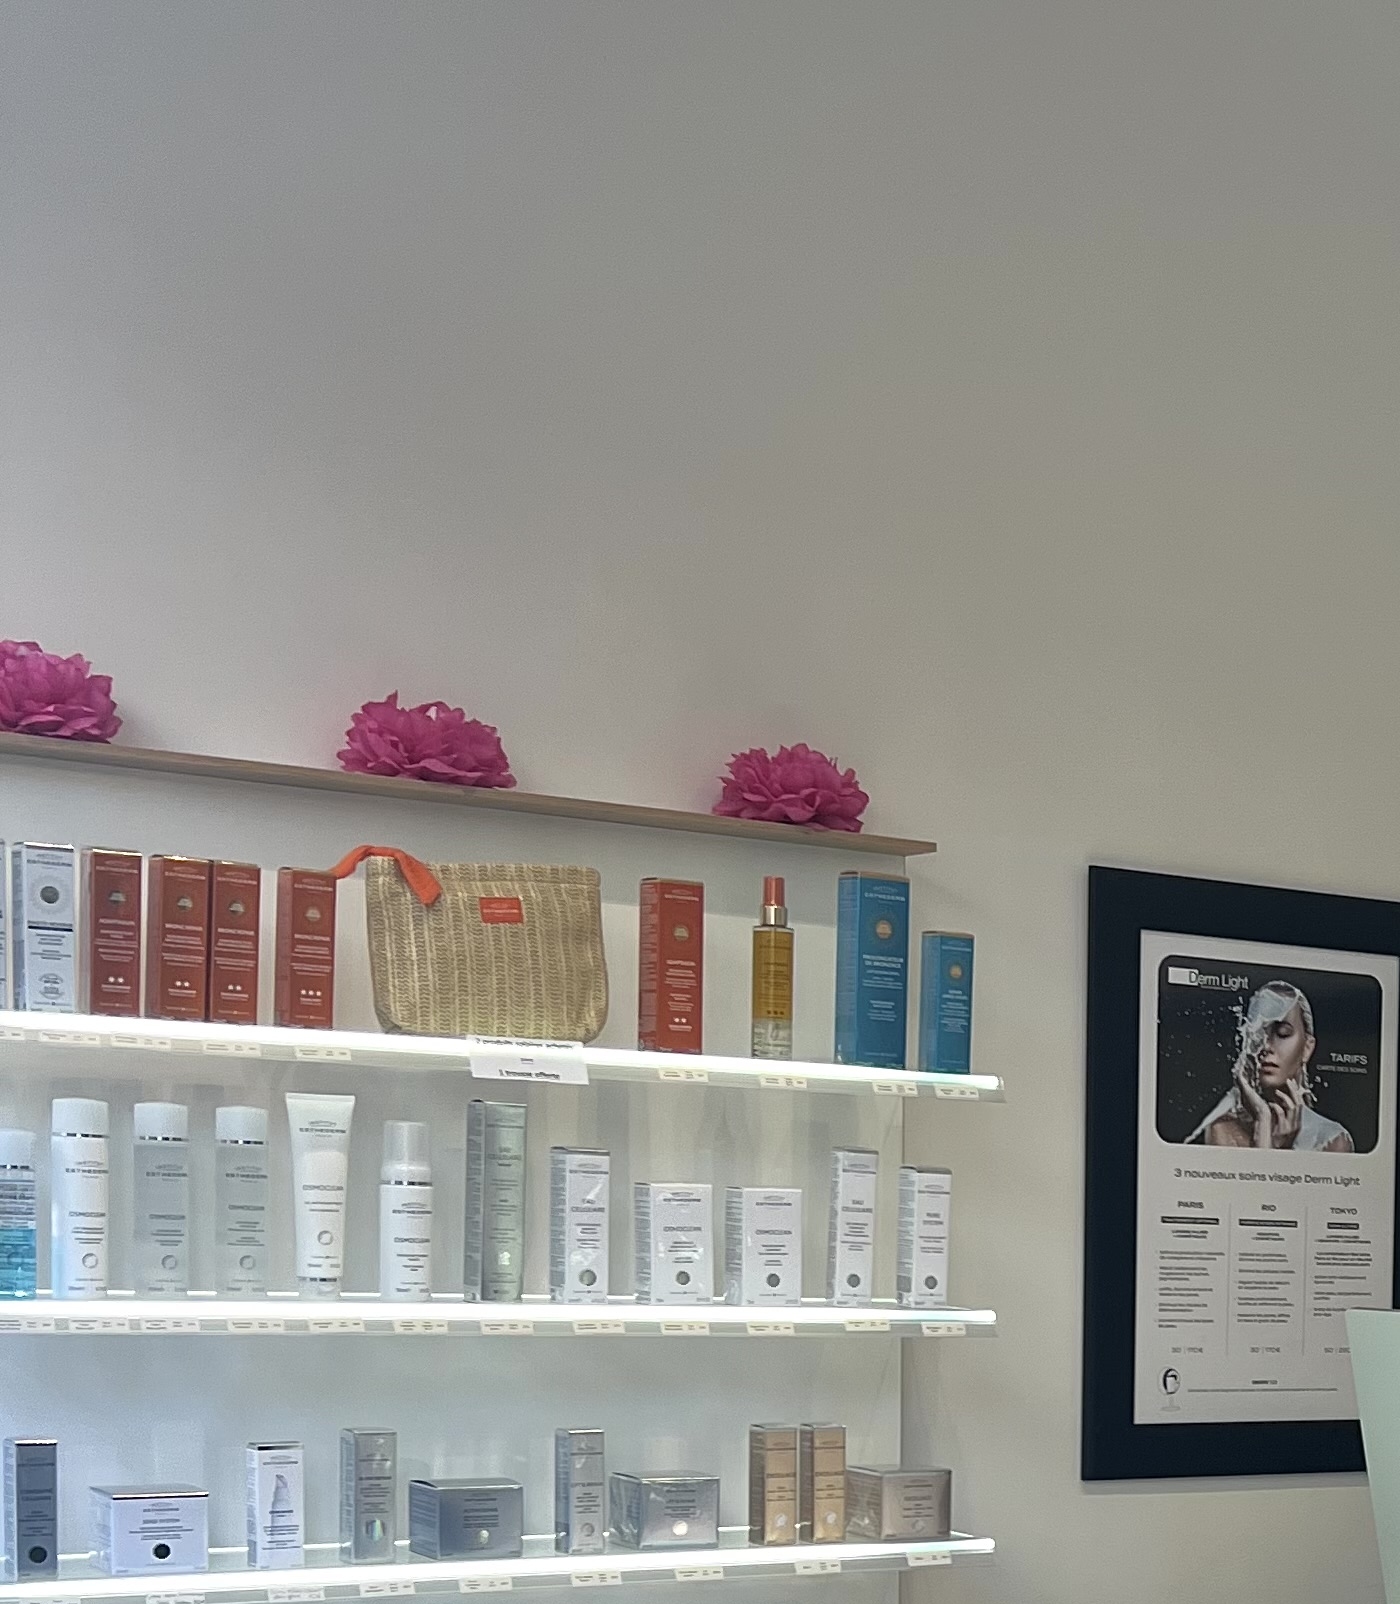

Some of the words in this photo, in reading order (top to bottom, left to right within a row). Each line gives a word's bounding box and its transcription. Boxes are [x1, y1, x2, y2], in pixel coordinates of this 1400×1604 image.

[1189, 970, 1220, 986] Derm
[1221, 974, 1249, 992] Light
[1330, 1052, 1368, 1065] TARIFS
[1174, 1168, 1182, 1178] 3
[1184, 1169, 1237, 1180] nouveaux
[1238, 1171, 1267, 1182] soins
[1268, 1172, 1303, 1185] visage
[1304, 1174, 1333, 1185] Derm
[1334, 1175, 1361, 1187] Light
[1177, 1200, 1204, 1209] PARIS
[1261, 1204, 1277, 1212] RIO
[1329, 1206, 1358, 1215] TOKYO
